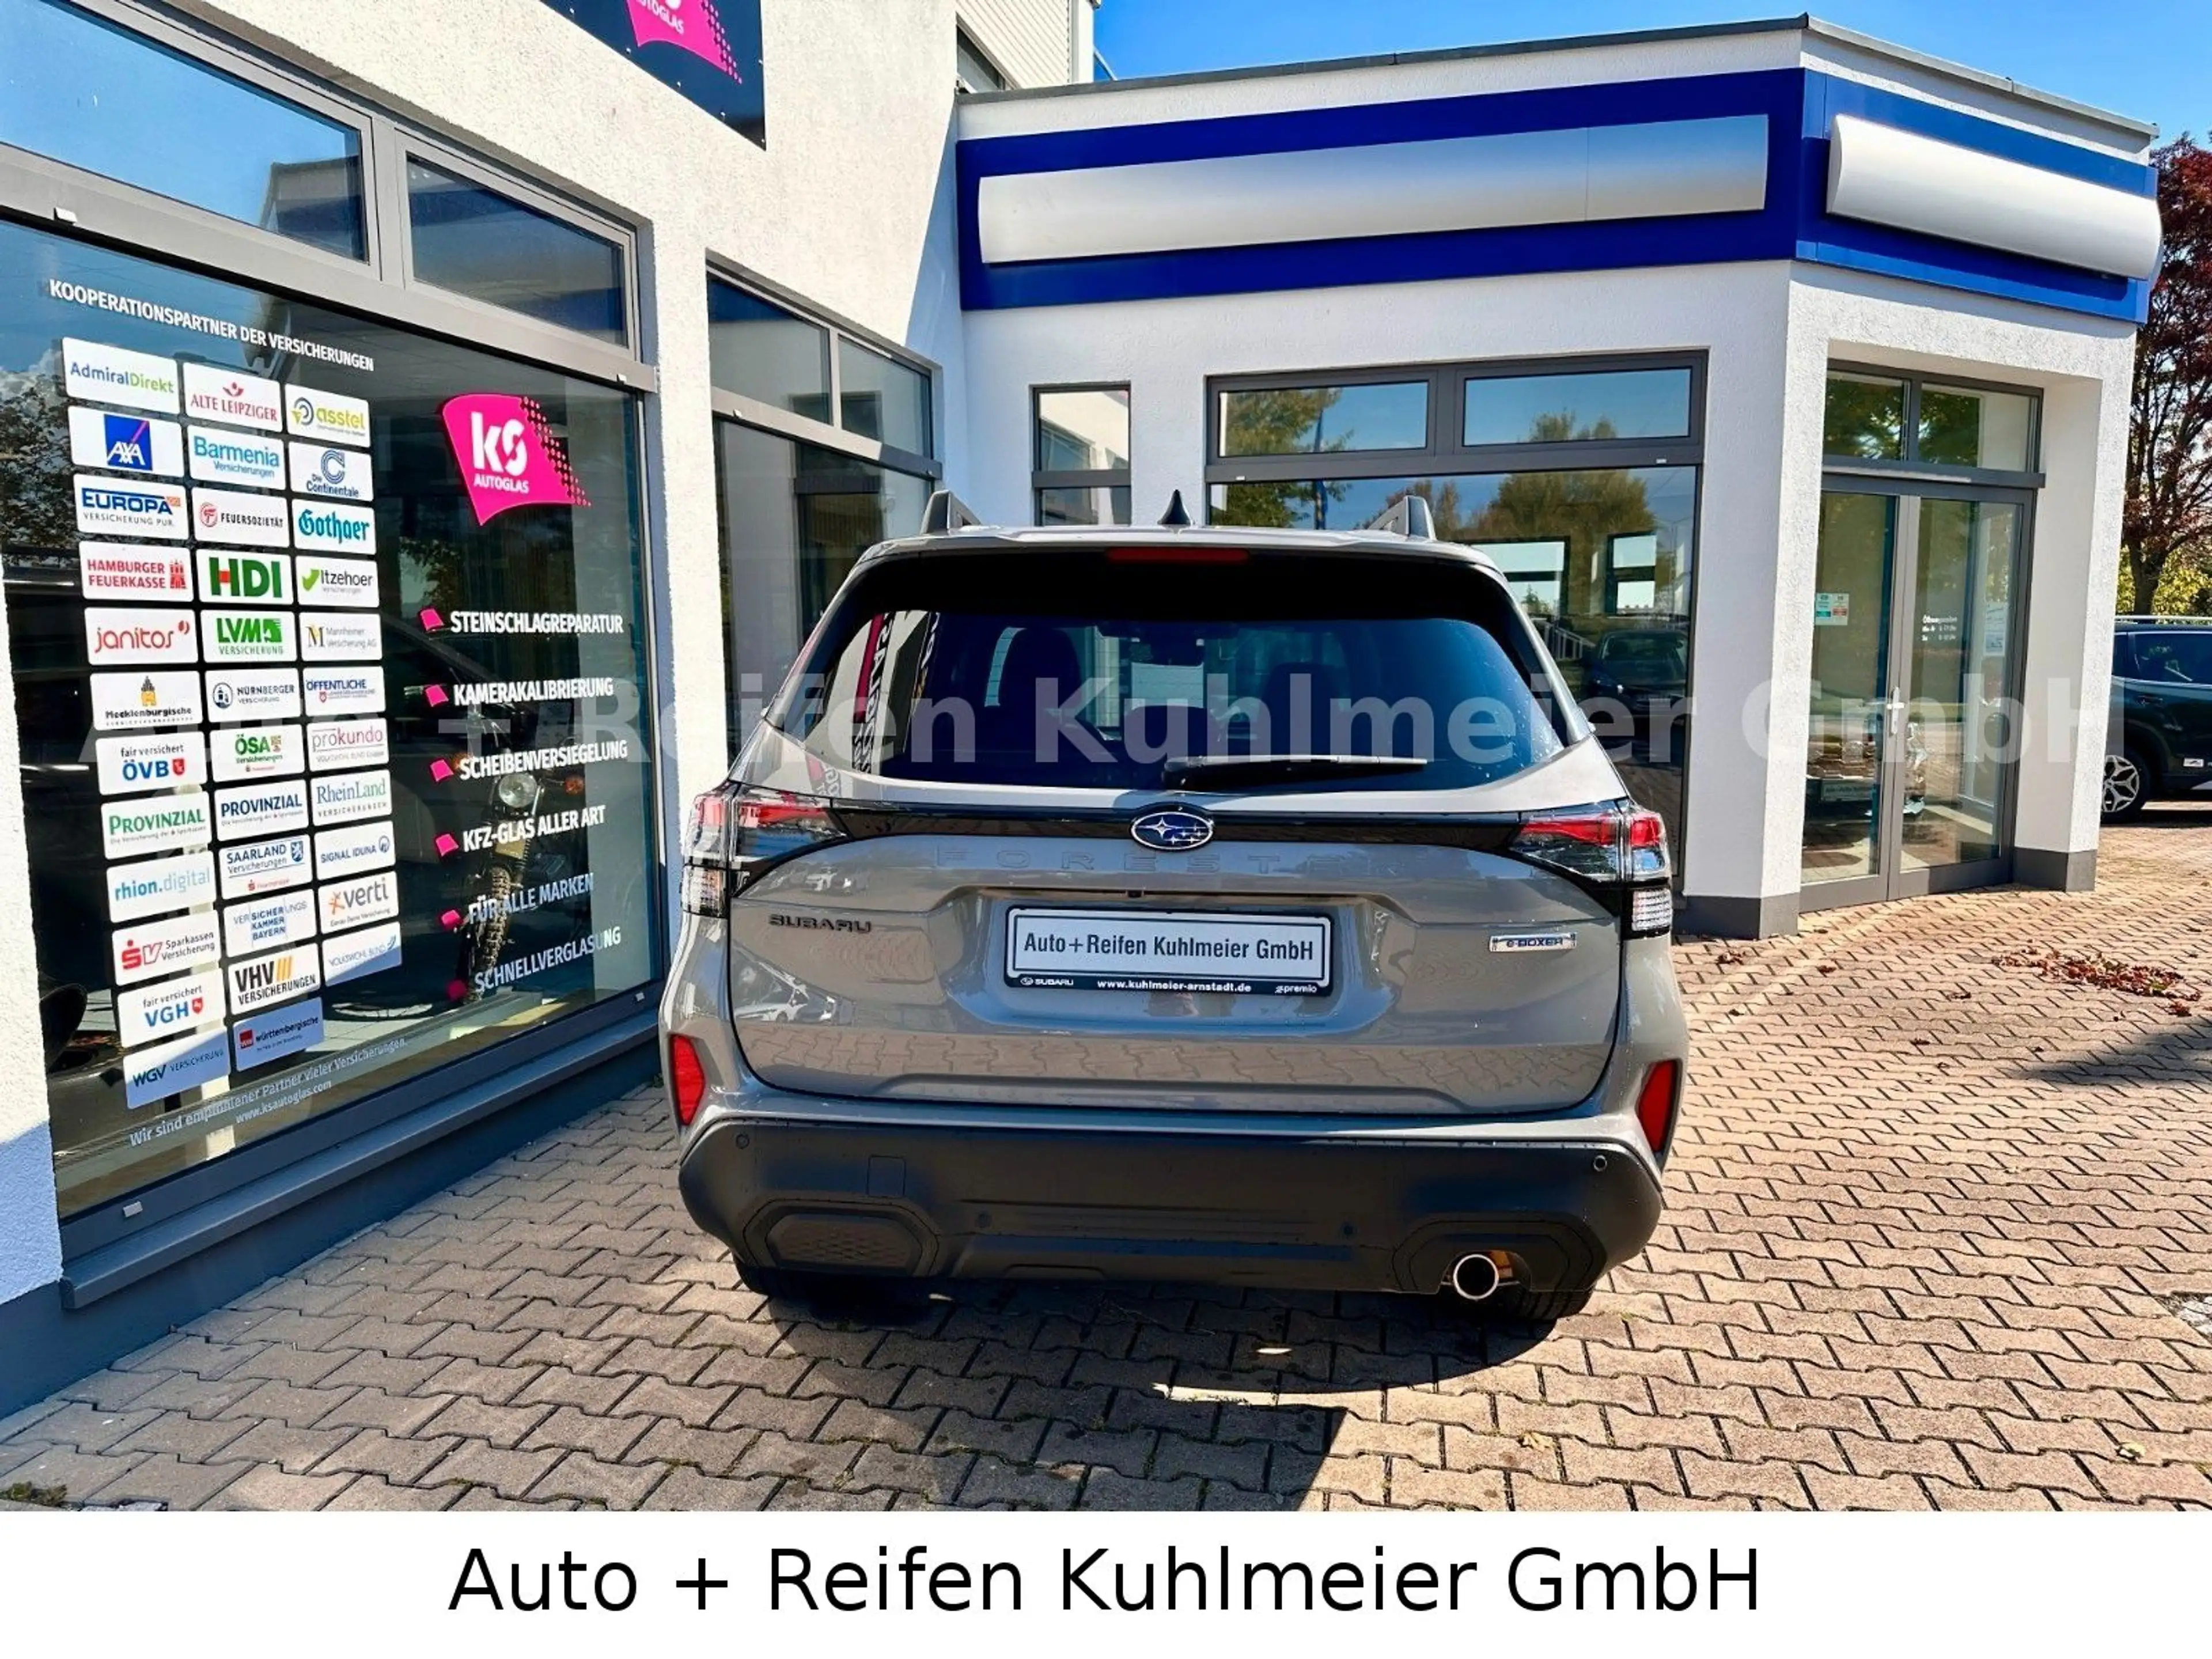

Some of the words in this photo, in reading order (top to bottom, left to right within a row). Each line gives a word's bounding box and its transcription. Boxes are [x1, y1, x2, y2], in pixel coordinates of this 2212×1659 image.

[638, 0, 684, 35] TOGLAS
[50, 279, 237, 340] KOOPERATIONSPARTNER
[240, 325, 267, 346] DER
[267, 332, 374, 372] VERSICHERUNGEN
[70, 362, 174, 393] AdmiralDirekt
[191, 393, 218, 410] ALTE
[221, 399, 277, 421] LEIPZIGER
[316, 407, 365, 429] asstel
[108, 441, 145, 465] AXA
[194, 435, 279, 467] Barmenia
[213, 461, 275, 479] Versicherungen
[306, 482, 359, 498] Continentale
[474, 474, 529, 494] AUTOGLAS
[81, 487, 172, 515] EUROPA
[83, 512, 153, 525] VERSICHERUNG
[221, 512, 283, 528] FEUERSOZIETÄT
[298, 509, 370, 544] Gothaer
[87, 559, 165, 574] HAMBURGER
[209, 556, 282, 598] HDI
[321, 570, 373, 586] Itzehoer
[88, 575, 165, 589] FEUERKASSE
[217, 618, 260, 643] LVM
[450, 611, 624, 634] STEINSCHLAGREPARATUR
[94, 627, 174, 653] janitos
[218, 646, 283, 655] VERSICHERUNG
[237, 684, 294, 695] NÜRNBERGER
[306, 679, 366, 691] ÖFFENTLICHE
[453, 677, 613, 706] KAMERAKALIBRIERUNG
[105, 708, 192, 719] Mecklenburgische
[121, 748, 137, 757] fair
[139, 744, 184, 756] versichert
[235, 734, 271, 755] ÖSA
[312, 726, 383, 752] prokundo
[122, 759, 169, 781] ÖVB
[459, 740, 628, 781] SCHEIBENVERSIEGELUNG
[317, 779, 386, 804] RheinLand
[221, 793, 302, 817] PROVINZIAL
[318, 802, 387, 817] VERSICHERUNGEN
[109, 809, 206, 835] PROVINZIAL
[463, 818, 536, 852] KFZ-GLAS
[536, 809, 579, 836] ALLER
[581, 804, 607, 826] ART
[227, 844, 286, 864] SAARLAND
[228, 857, 287, 873] Versicherungen
[321, 850, 351, 863] SIGNAL
[353, 845, 377, 856] IDUNA
[115, 867, 210, 900] rhion.digital
[344, 877, 388, 908] verti
[468, 894, 498, 924] FÜR
[499, 888, 536, 915] ALLE
[539, 872, 594, 905] MARKEN
[252, 916, 285, 930] KAMMER
[252, 926, 286, 940] BAYERN
[769, 914, 872, 934] SUBARU
[161, 942, 215, 960] Versicherung
[165, 931, 214, 949] Sparkassen
[1153, 936, 1249, 958] Kuhlmeier
[1256, 938, 1313, 960] GmbH
[474, 926, 622, 993] SCHNELLVERGLASUNG
[235, 961, 275, 992] VHV
[1097, 979, 1251, 993] www.kuhlmeier-arnstadt.de
[1283, 984, 1317, 994] premio
[143, 998, 158, 1008] fair
[161, 985, 202, 1003] versichert
[238, 975, 316, 1005] VERSICHERUNGEN
[145, 1001, 189, 1027] VGH
[132, 1065, 167, 1087] WGV
[129, 1128, 152, 1146] Wir
[156, 1115, 183, 1138] sind
[263, 1072, 303, 1097] Partner
[305, 1062, 335, 1081] vieler
[236, 1081, 331, 1123] www.ksautoglas.com
